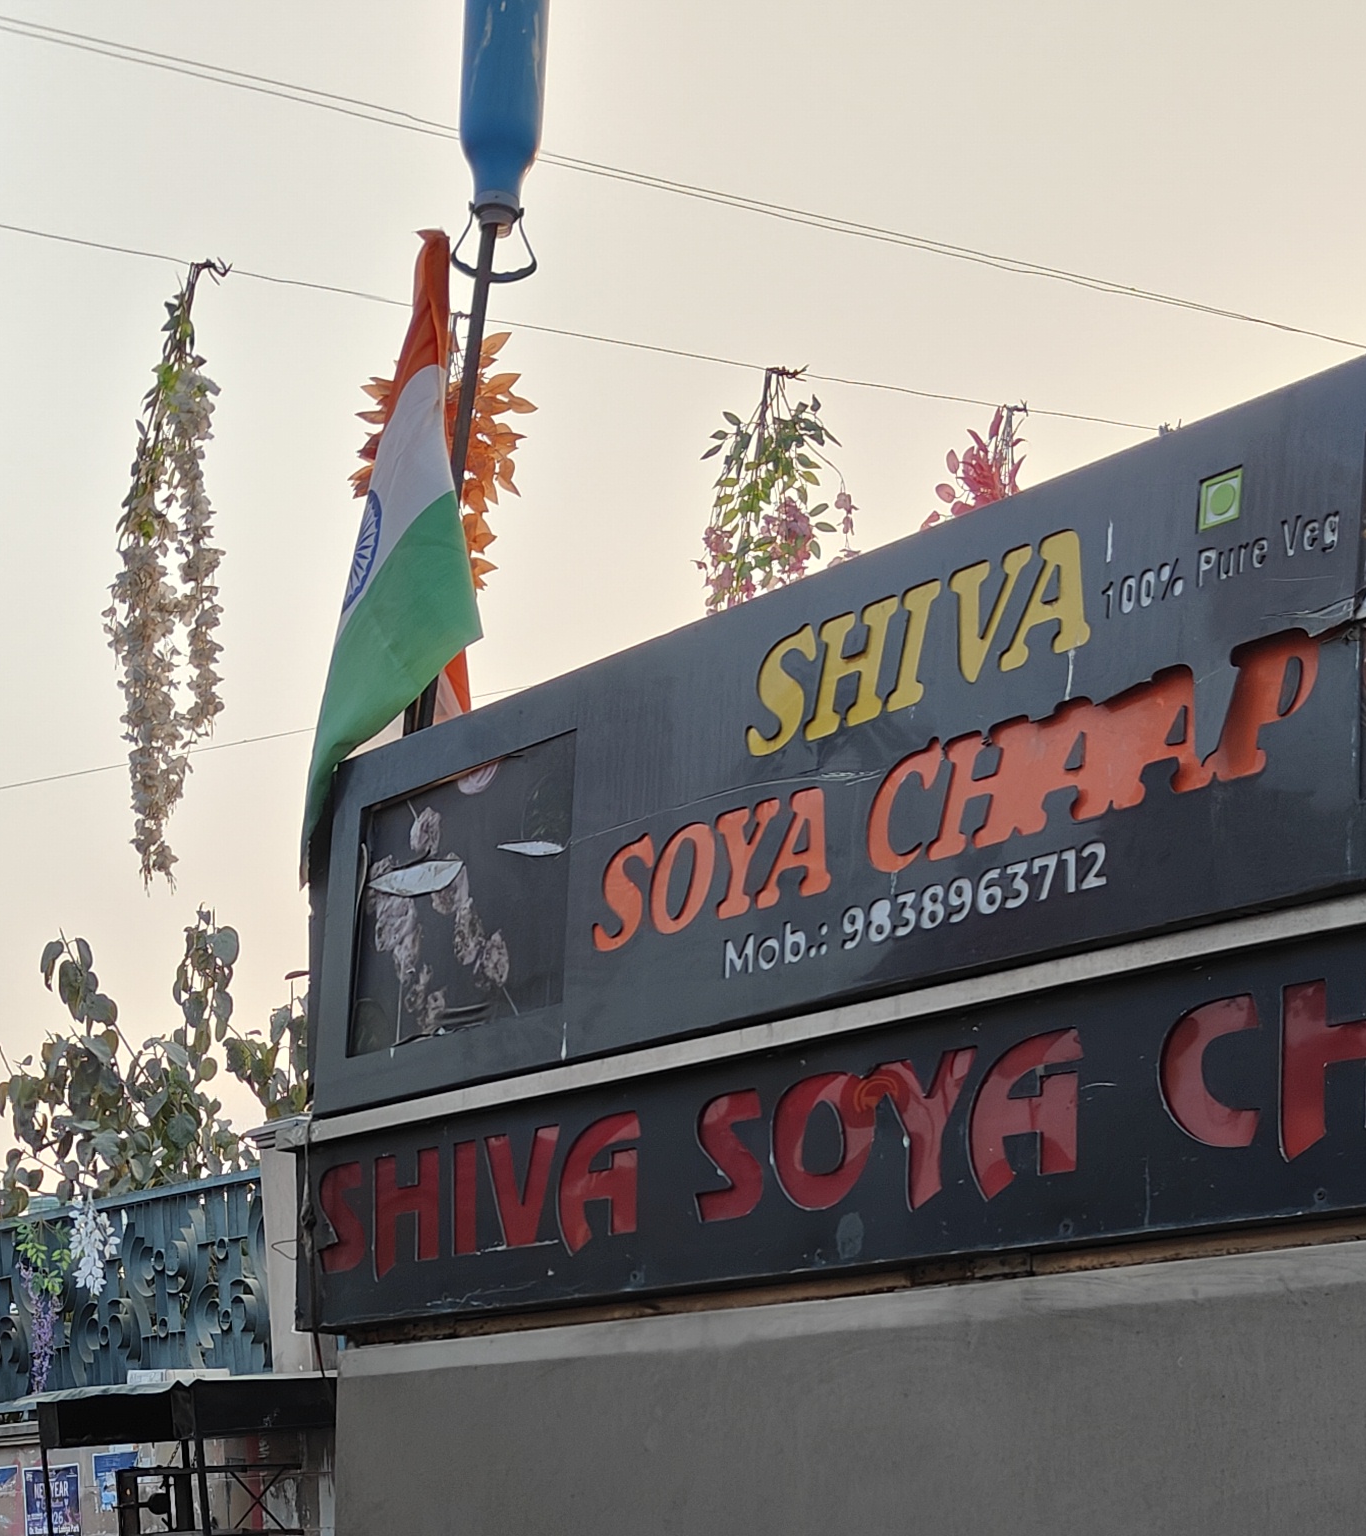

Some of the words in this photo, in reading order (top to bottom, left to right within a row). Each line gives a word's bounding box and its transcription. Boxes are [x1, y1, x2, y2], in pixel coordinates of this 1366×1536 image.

[746, 528, 1091, 757] SHIVA
[1101, 558, 1184, 619] 100%
[1198, 537, 1268, 588] Pure
[1281, 511, 1340, 557] Veg
[592, 787, 831, 952] SOYA
[866, 626, 1320, 874] CHAAP
[841, 841, 1107, 951] 9838963712
[318, 1110, 641, 1282] SHIVA
[694, 1026, 1084, 1223] SOYA
[50, 1481, 68, 1498] YEAR
